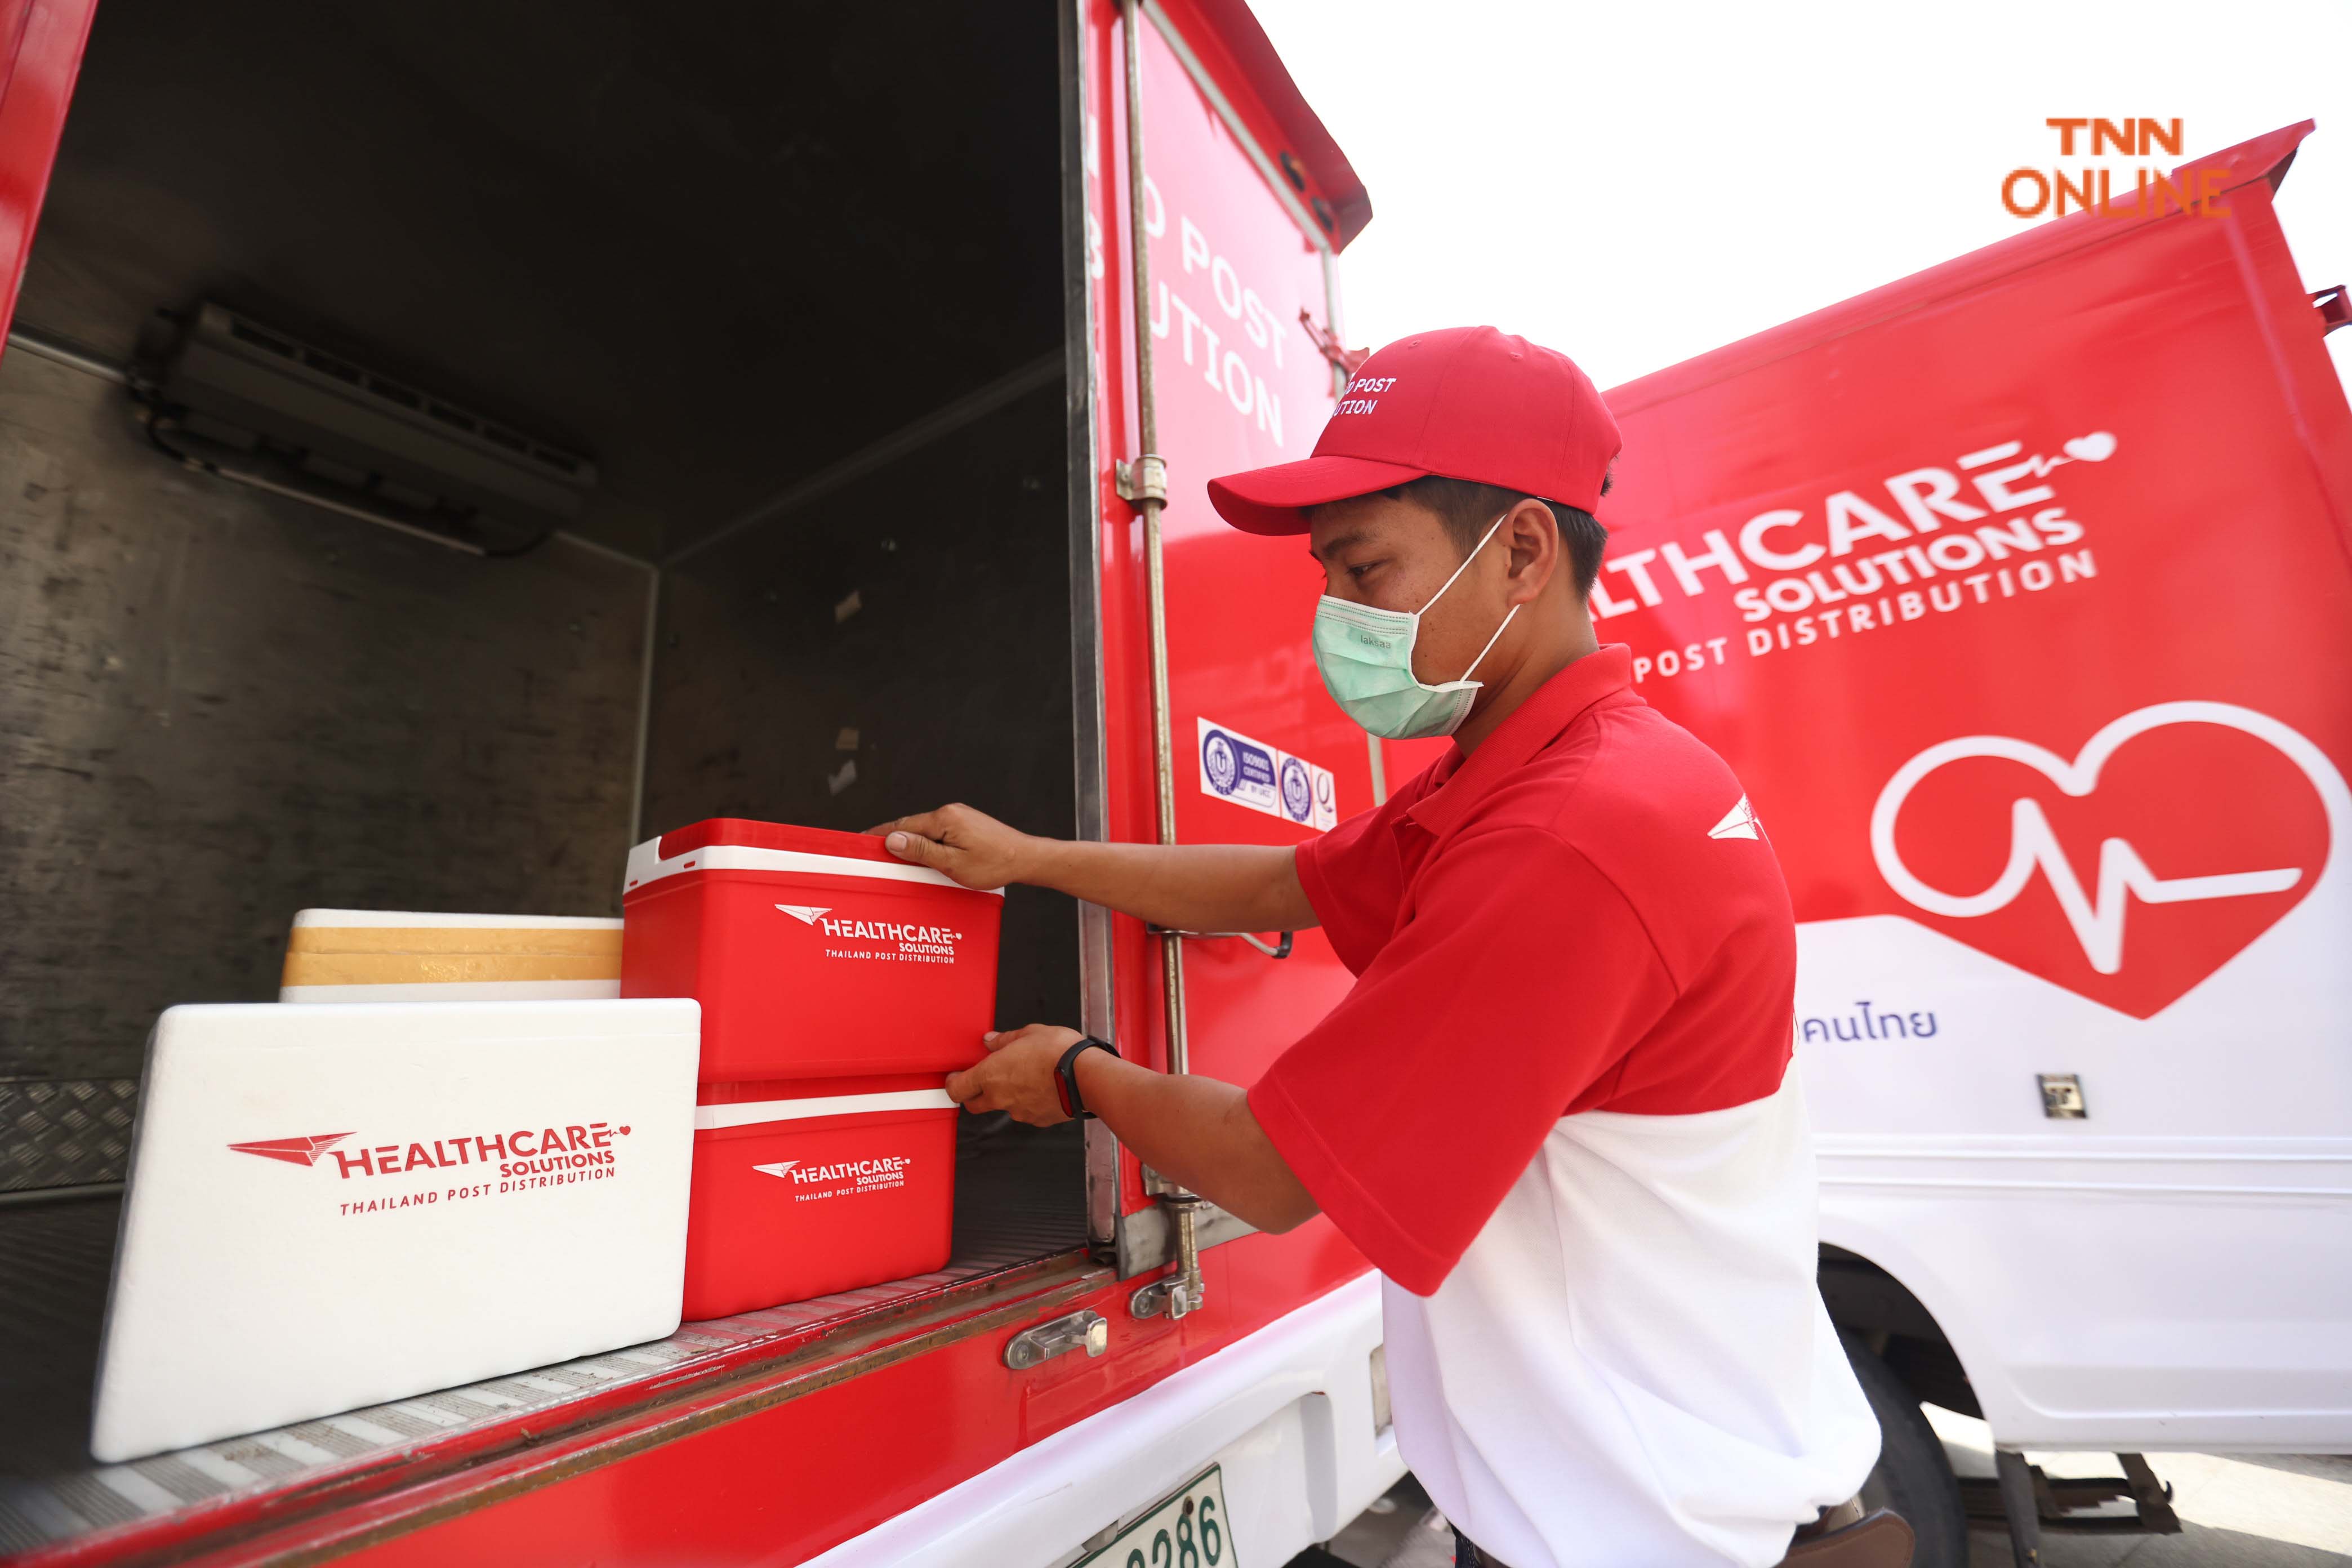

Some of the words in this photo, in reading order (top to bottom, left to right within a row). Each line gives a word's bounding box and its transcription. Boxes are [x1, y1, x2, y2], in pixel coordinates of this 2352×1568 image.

[1181, 214, 1287, 370] POST
[1353, 378, 1397, 393] POST
[1589, 440, 2056, 622] LTHCARE
[1734, 507, 2085, 622] SOLUTIONS
[1633, 636, 1728, 683] POST
[1747, 549, 2097, 656] DISTRIBUTION
[819, 918, 953, 945] HEALTHCARE
[899, 943, 955, 955] SOLUTIONS
[825, 950, 871, 959] THAILAND
[899, 954, 955, 964] DISTRIBUTION
[1803, 1001, 1937, 1043] คนไทย
[326, 1122, 614, 1179] HEALTHCARE
[500, 1150, 615, 1178] SOLUTIONS
[789, 1156, 903, 1184] HEALTHCARE
[856, 1171, 904, 1185] SOLUTIONS
[340, 1192, 438, 1217] THAILAND
[447, 1184, 492, 1201] POST
[500, 1166, 615, 1193] DISTRIBUTION
[795, 1191, 832, 1202] THAILAND
[836, 1187, 854, 1196] POST
[857, 1181, 904, 1193] DISTRIBUTION
[1127, 1495, 1221, 1568] 286
